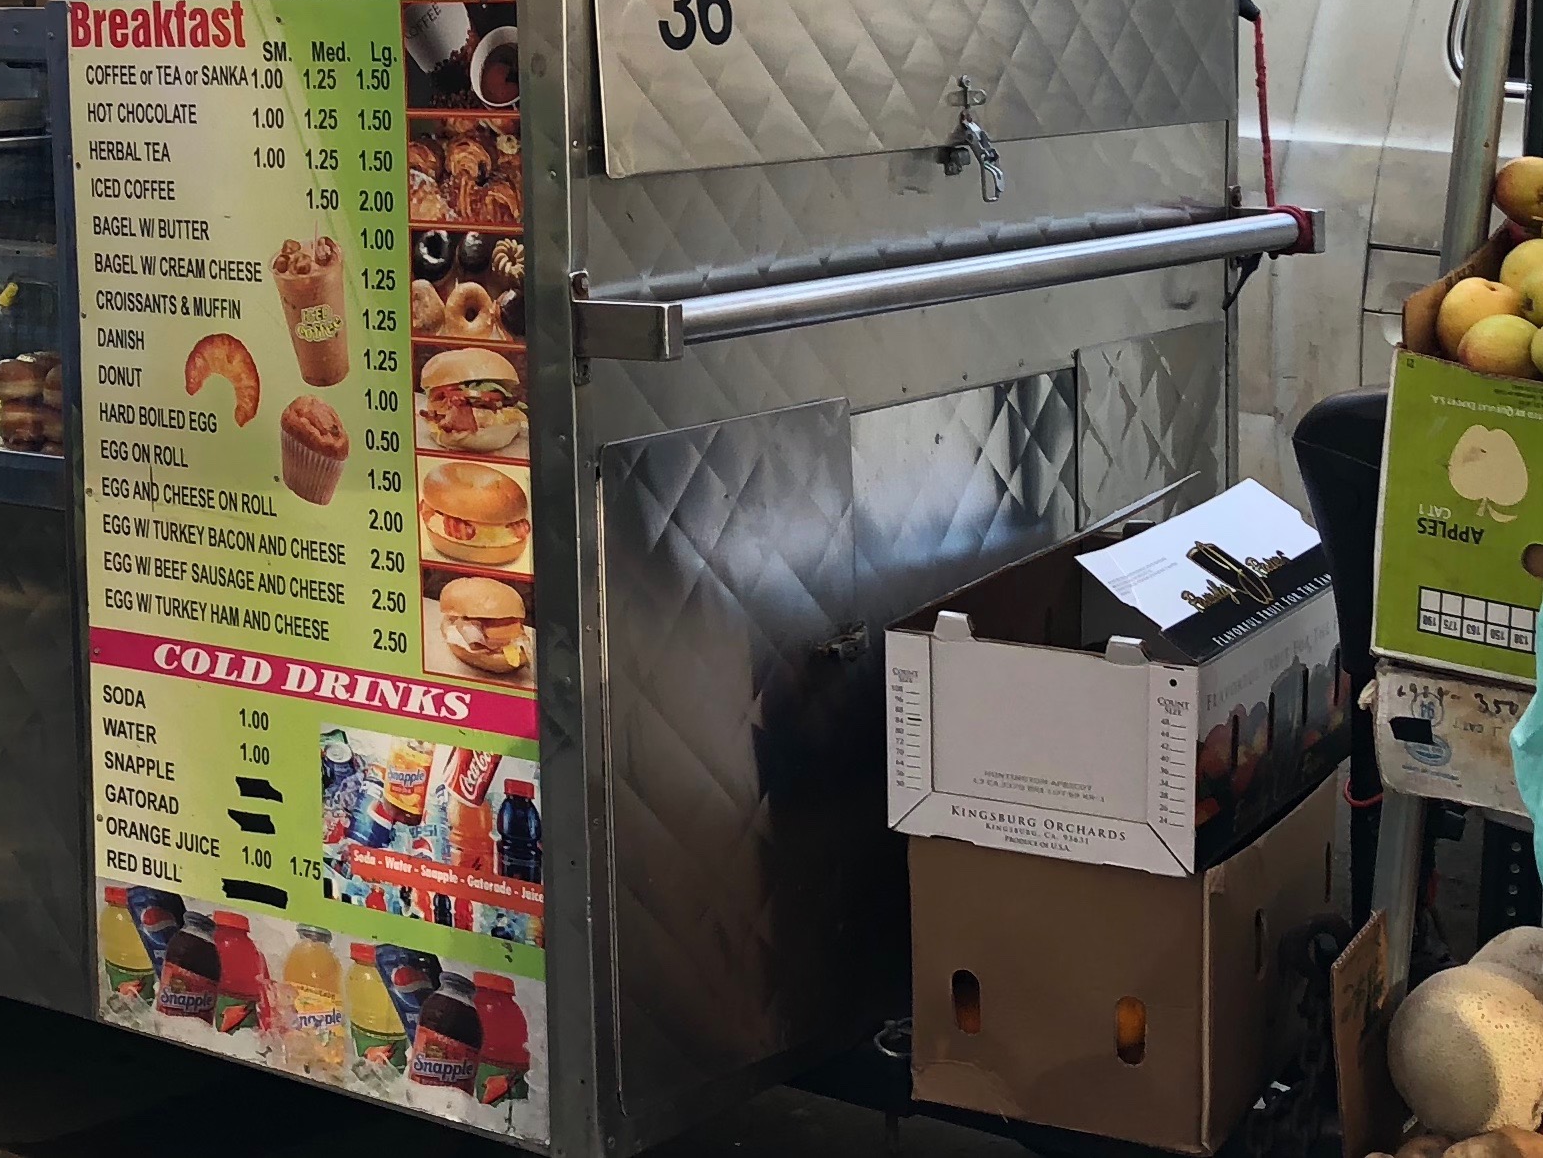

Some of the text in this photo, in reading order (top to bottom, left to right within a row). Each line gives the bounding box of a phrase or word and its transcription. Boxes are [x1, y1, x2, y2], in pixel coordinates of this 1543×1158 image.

[70, 0, 246, 48] Breakfast
[263, 41, 397, 67] SM. Med. Lg.
[86, 65, 390, 90] COFFEE or TEA or SANKA 1.00 1.25 1.50
[88, 103, 391, 131] HOT CHOCOLATE 1.00 1.25 1.50
[89, 141, 392, 172] HERBAL TEA 1.00 1.25 1.50
[91, 178, 393, 212] ICED COFFEE 1.50 2.00
[93, 216, 394, 250] BAGEL W/ BUTTER 1.00
[94, 253, 395, 291] BAGEL W/ CREAM CHEESE 1.25
[96, 290, 397, 332] CROISSANTS & MUFFIN 1.25
[98, 328, 397, 372] DANISH 1.25
[99, 365, 398, 412] DONUT 1.00
[100, 402, 399, 452] HARD BOILED EGG 0.50
[101, 440, 401, 492] EGG ON ROLL 1.50
[102, 477, 403, 533] EGG AND CHEESE ON ROLL 2.00
[1427, 504, 1452, 520] CAT
[103, 514, 405, 573] EGG W/ TURKEY BACON AND CHEESE 2.50
[1417, 517, 1484, 545] APPLES
[104, 551, 406, 613] EGG W/ BEEF SAUSAGE AND CHEESE 2.50
[105, 589, 406, 653] EGG W/ TURKEY HAM AND CHEESE 2.50
[1444, 619, 1458, 632] 175
[1466, 624, 1481, 636] 163
[154, 643, 472, 720] COLD DRINKS
[103, 685, 269, 731] SODA 1.00
[1157, 697, 1190, 710] COUNT
[103, 717, 270, 765] WATER 1.00
[105, 751, 175, 781] SNAPPLE
[105, 784, 179, 814] GATORAD
[951, 805, 1126, 841] KINGSBURG ORCHARDS
[106, 817, 321, 880] ORANGE JUICE 1.00 1.75
[107, 849, 182, 883] RED BULL
[354, 850, 544, 903] Soda Water Snapple Gatorade Juice
[160, 987, 213, 1012] Snapple
[413, 1053, 474, 1082] Snapple
